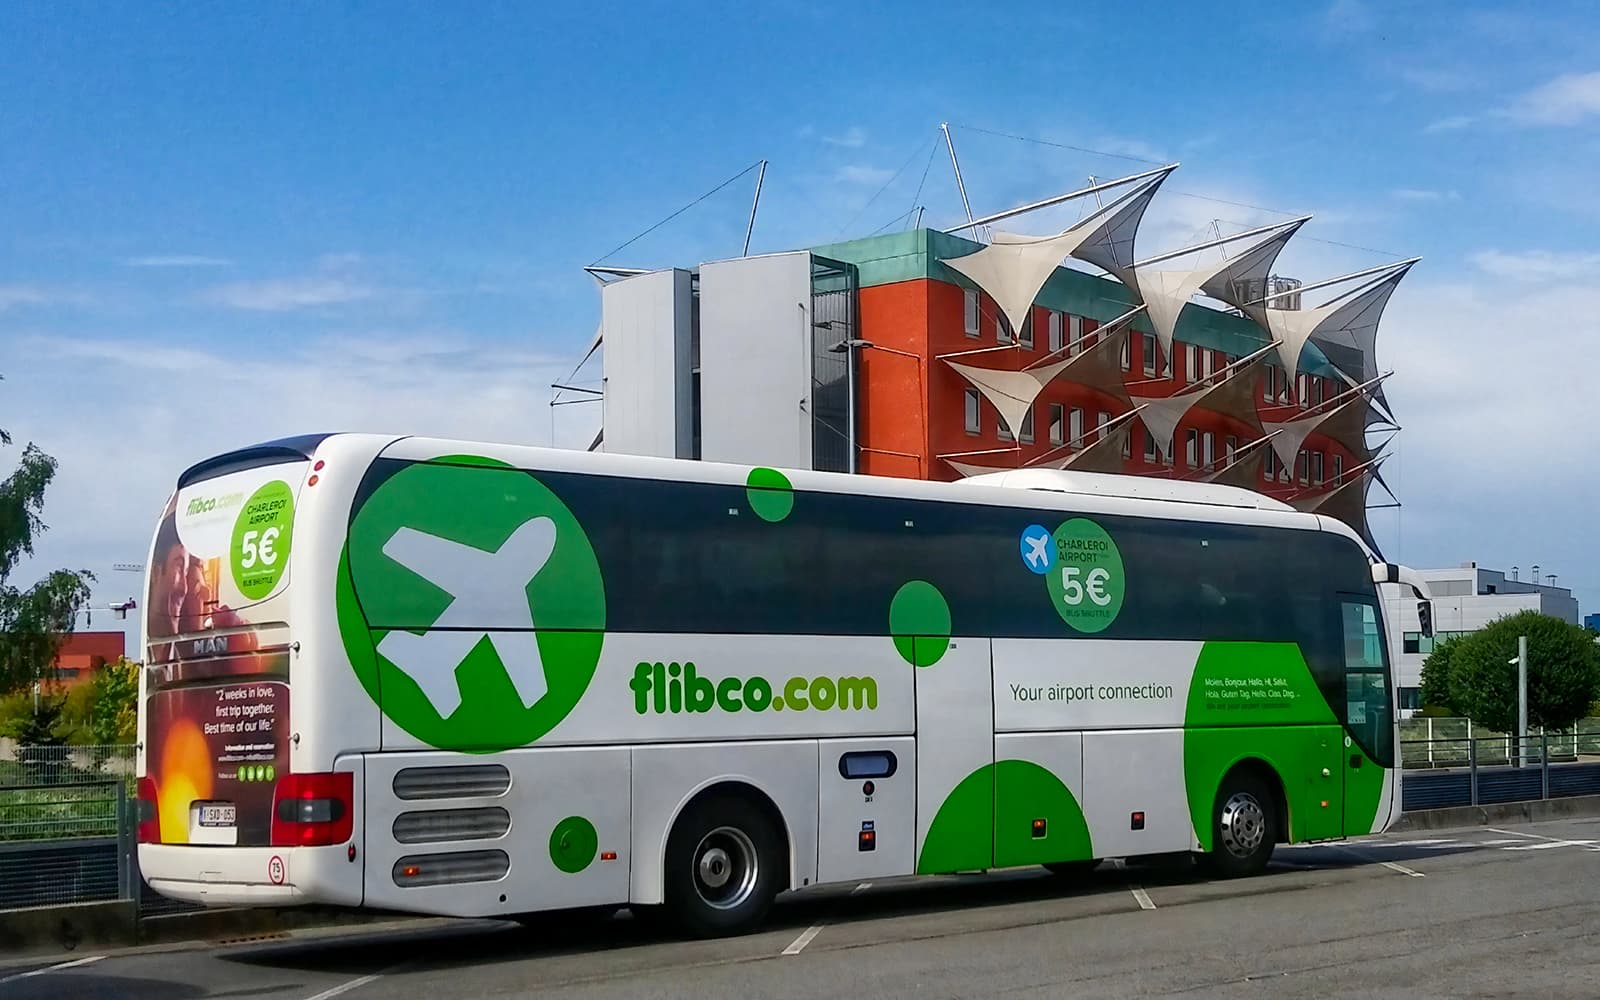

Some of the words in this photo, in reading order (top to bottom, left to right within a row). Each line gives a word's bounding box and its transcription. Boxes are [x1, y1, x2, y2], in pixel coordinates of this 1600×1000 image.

[247, 499, 287, 514] CHARLEROI
[249, 511, 279, 524] AIRPORT
[1057, 538, 1109, 552] CHARLEROI
[1059, 552, 1098, 563] AIRPORT
[1062, 567, 1111, 606] 5€
[194, 637, 228, 654] MAN
[225, 688, 247, 700] weeks
[248, 687, 256, 698] in
[256, 686, 275, 698] love,
[629, 661, 878, 714] flibco.com
[1010, 684, 1043, 702] Your
[1048, 684, 1094, 704] airport
[1098, 682, 1173, 700] connection
[215, 705, 228, 717] first
[229, 705, 241, 719] trip
[204, 722, 219, 735] Best
[220, 722, 235, 734] time
[236, 720, 244, 733] of
[244, 721, 258, 732] our
[272, 862, 281, 873] 75
